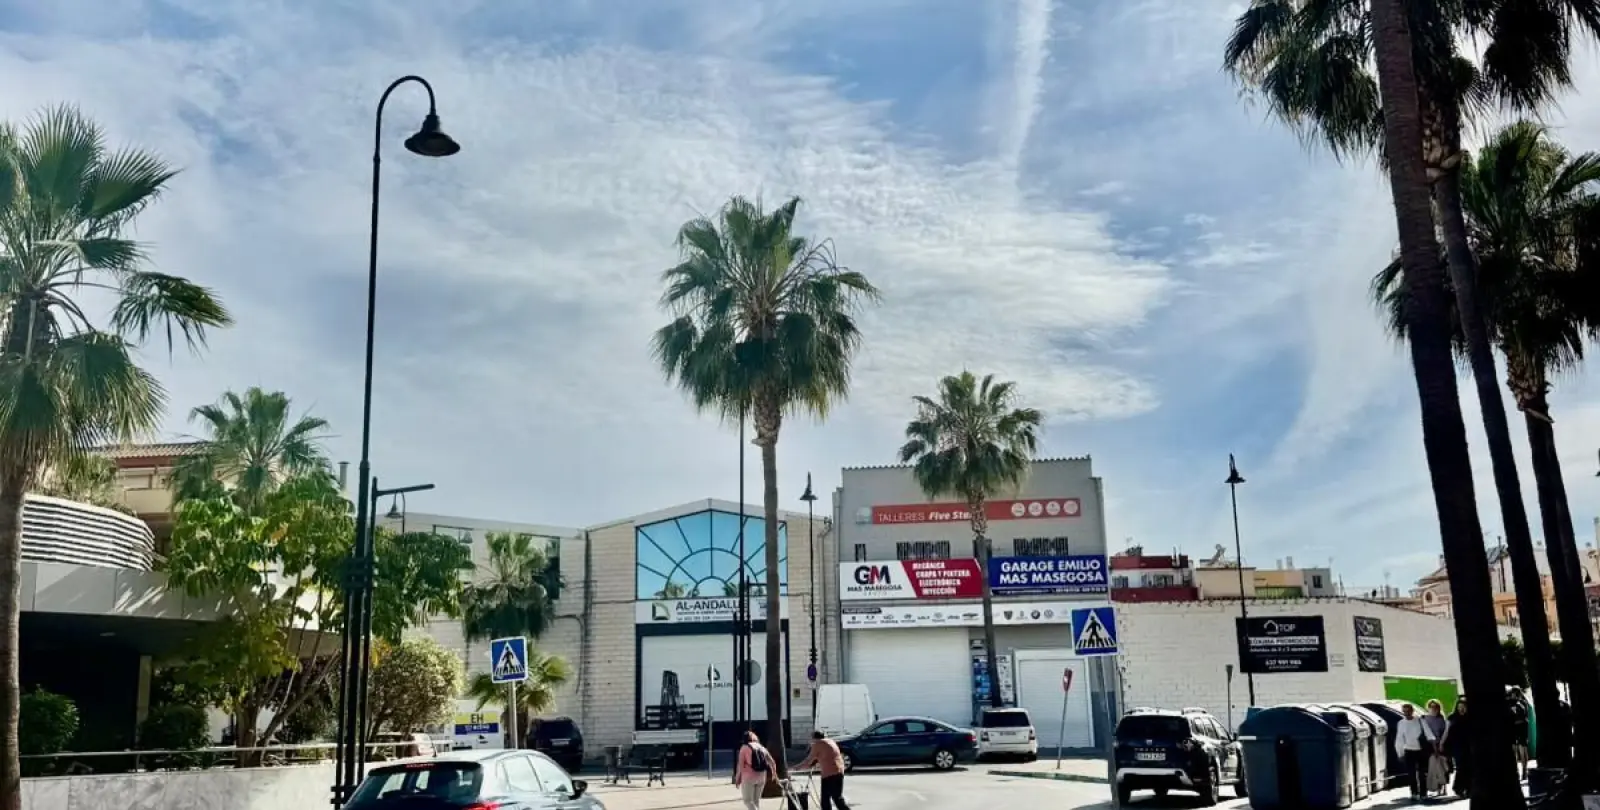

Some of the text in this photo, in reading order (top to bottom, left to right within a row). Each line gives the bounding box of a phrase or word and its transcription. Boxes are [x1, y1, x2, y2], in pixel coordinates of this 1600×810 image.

[878, 511, 925, 522] TALLERES
[928, 510, 950, 521] Five
[1001, 559, 1101, 573] GARAGE EMILIO
[854, 565, 891, 585] GM
[999, 571, 1105, 584] MAS MASEGOSA
[864, 584, 903, 592] MASEGOSA
[1279, 623, 1296, 632] TOP
